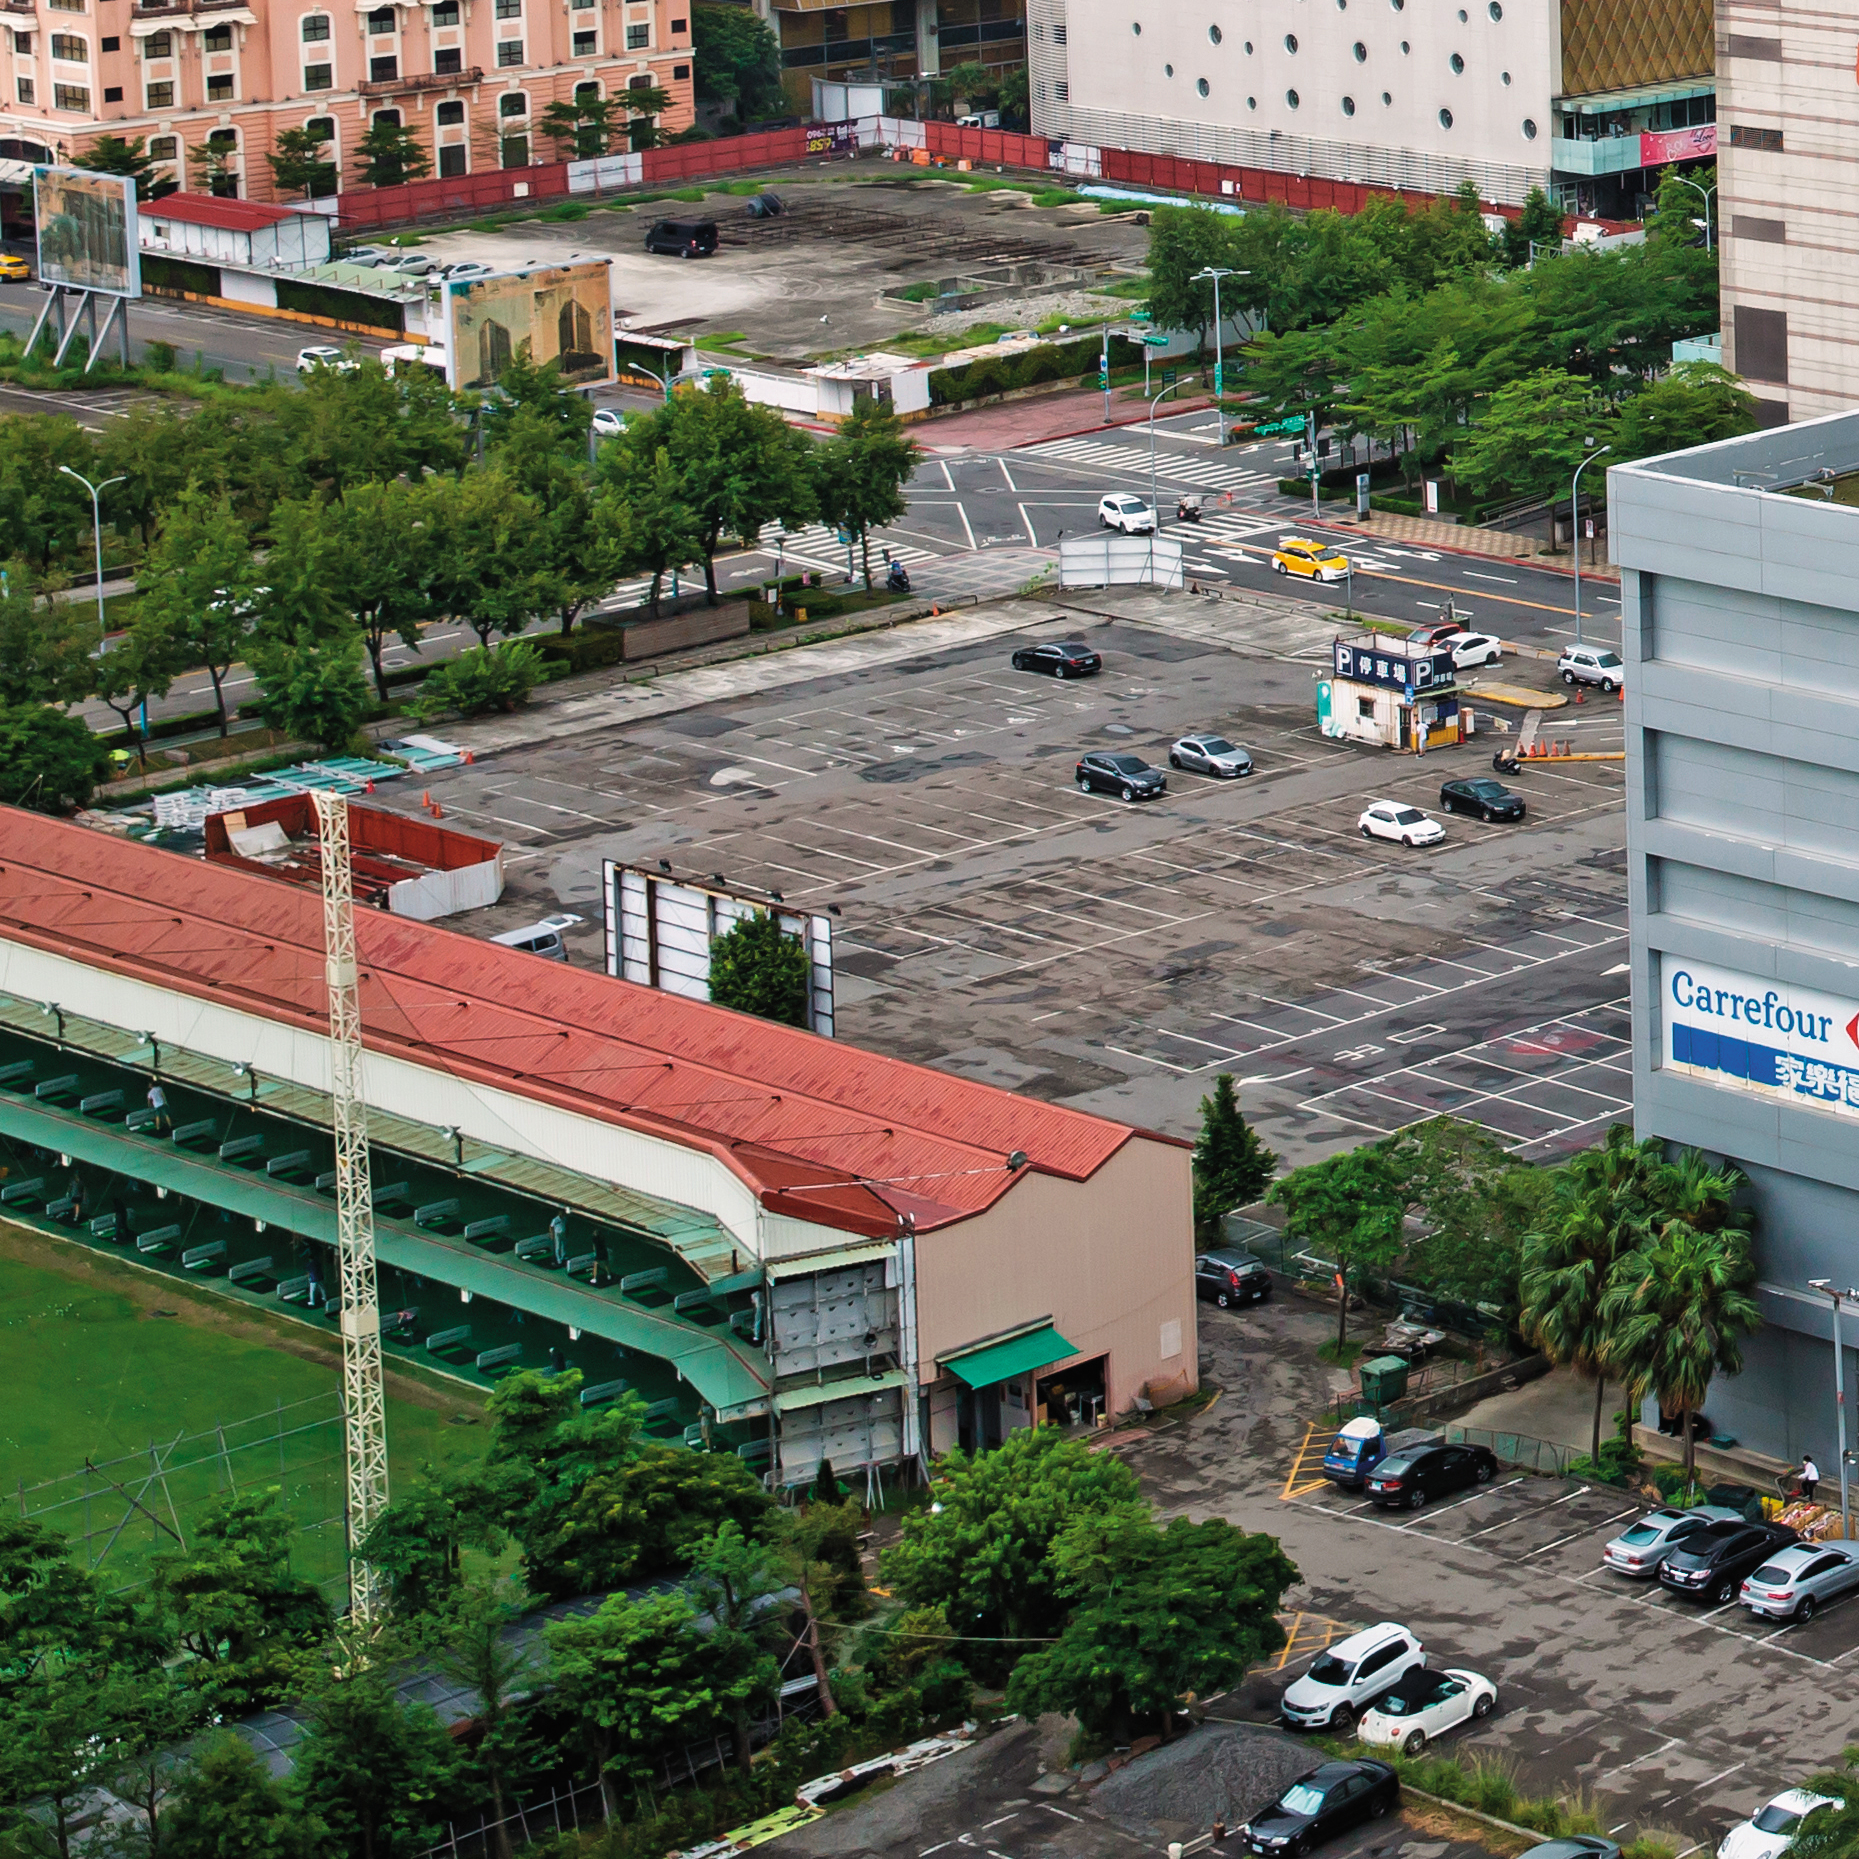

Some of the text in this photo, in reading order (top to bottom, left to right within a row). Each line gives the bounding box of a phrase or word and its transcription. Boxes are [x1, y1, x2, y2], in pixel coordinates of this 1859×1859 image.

[1338, 648, 1407, 684] P 停車場
[1415, 661, 1432, 687] P
[1672, 970, 1833, 1043] Carrefour
